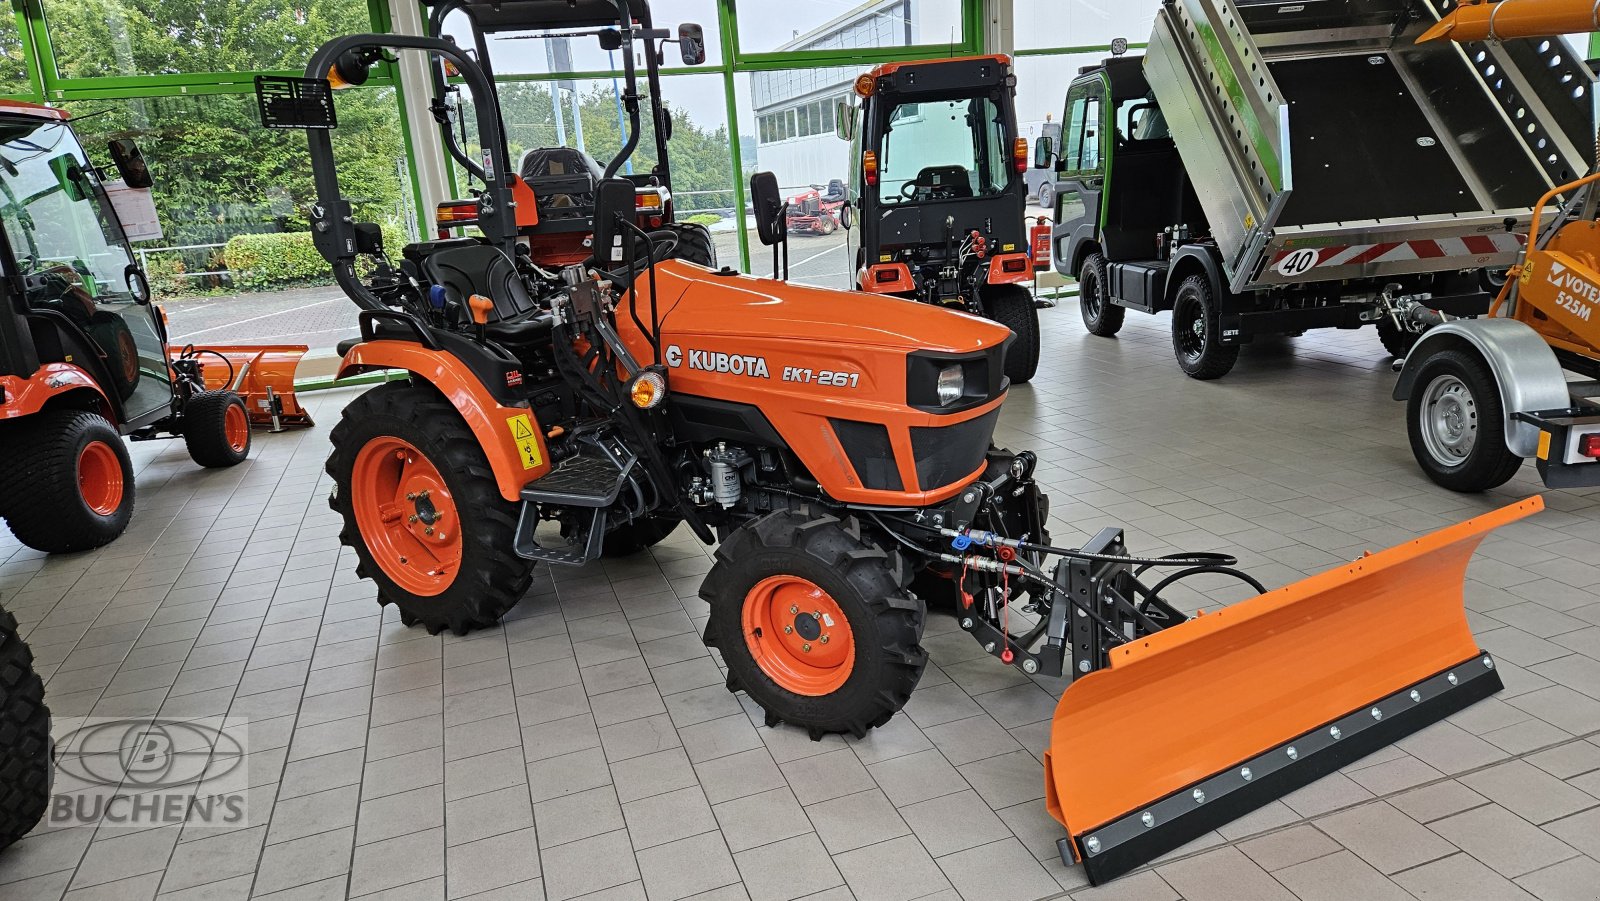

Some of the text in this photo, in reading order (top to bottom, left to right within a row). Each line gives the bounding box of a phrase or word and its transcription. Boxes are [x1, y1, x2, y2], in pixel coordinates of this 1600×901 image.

[1283, 251, 1314, 274] 40
[1555, 290, 1592, 321] 525M
[689, 349, 859, 388] KUBOTA EK1-261
